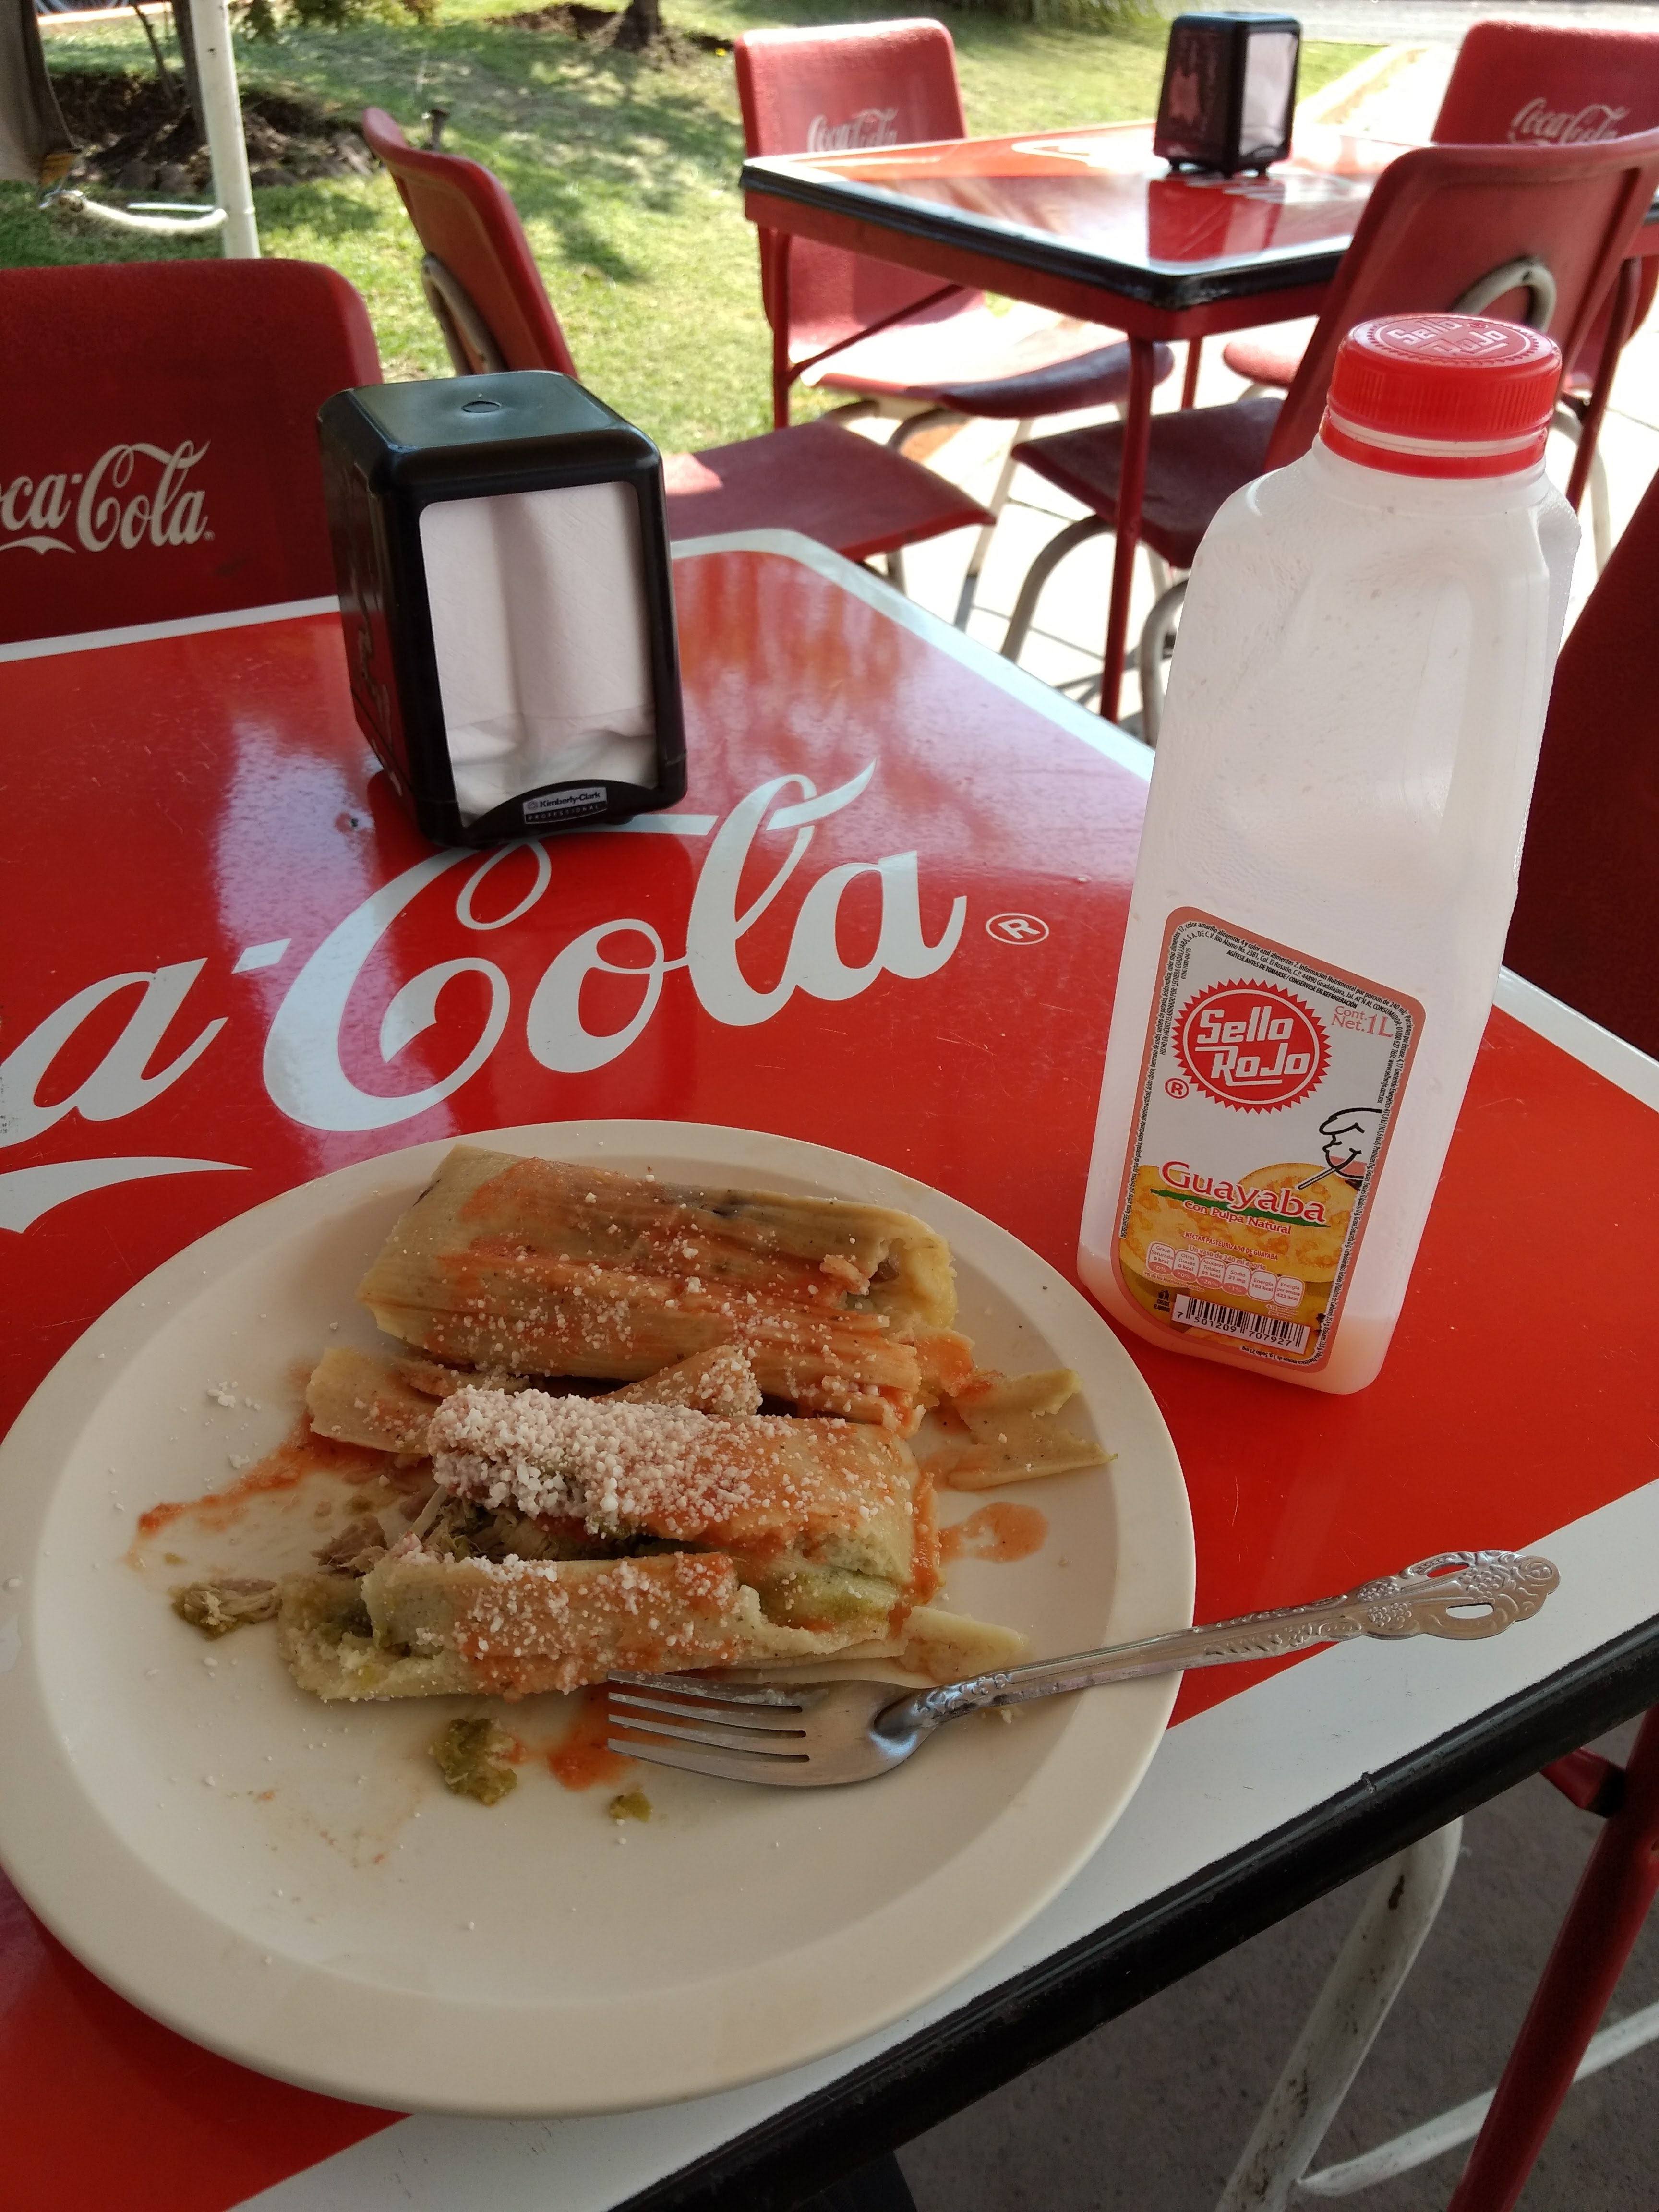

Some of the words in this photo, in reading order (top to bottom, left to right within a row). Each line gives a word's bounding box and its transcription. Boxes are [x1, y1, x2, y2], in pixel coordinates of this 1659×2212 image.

[0, 439, 211, 552] ca-Cola
[540, 792, 601, 808] Kimberly-Clark
[529, 805, 600, 821] PROFESSIONAL
[1198, 923, 1217, 932] amarillo
[1168, 931, 1180, 952] alimentos
[1217, 930, 1240, 943] alimentos
[1222, 937, 1239, 949] Álamo
[1175, 939, 1190, 968] GUADALAJARA,
[1246, 949, 1259, 960] 2381,
[1248, 943, 1260, 951] color
[1169, 951, 1178, 961] rojo
[1181, 947, 1191, 979] 01NG1000-04/15
[1260, 955, 1268, 963] Col.
[1270, 953, 1295, 965] alimentos
[1166, 960, 1174, 971] color
[1274, 962, 1292, 974] Rosario,
[1299, 964, 1327, 980] Información
[1162, 971, 1173, 986] málico,
[1171, 969, 1180, 986] LECHERA
[1226, 950, 1245, 961] AGÍTESE
[1244, 958, 1260, 967] ANTES
[1265, 966, 1286, 979] TOMARSE
[1289, 977, 1317, 991] CONSÉRVESE
[1322, 990, 1358, 1009] REFRIGERACIÓN
[1301, 974, 1317, 983] 44890
[1327, 976, 1357, 991] Nutrimental
[1317, 980, 1345, 997] Guadalajara,
[1355, 989, 1365, 997] por
[1354, 996, 1366, 1004] AT'N
[1364, 991, 1383, 1003] porción
[1157, 997, 1168, 1013] potasio,
[1165, 997, 1175, 1021] ELABORADO
[1334, 1005, 1367, 1021] Cont.
[1373, 1003, 1400, 1026] CONSUMIDOR:
[1161, 1020, 1171, 1036] MÉXICO
[1196, 1006, 1294, 1044] Sello
[1331, 1014, 1365, 1032] Net.
[1367, 1013, 1394, 1038] 1L
[1395, 1025, 1403, 1040] 01800
[1405, 1015, 1413, 1036] Porciones
[1153, 1033, 1162, 1045] sodio,
[1149, 1049, 1158, 1067] benzoato
[1389, 1049, 1398, 1059] 7656
[1398, 1044, 1408, 1059] Envase:
[1396, 1059, 1404, 1068] 4,17
[1147, 1067, 1156, 1080] cítrico,
[1390, 1068, 1402, 1089] Contenido
[1377, 1059, 1394, 1104] www.sellorojo.com.mx
[1143, 1090, 1152, 1106] artificial,
[1384, 1088, 1396, 1109] Energético
[1140, 1106, 1148, 1121] sintético
[1381, 1108, 1391, 1119] 431,8
[1136, 1121, 1146, 1142] saborizante
[1377, 1124, 1386, 1136] (101,6
[1373, 1136, 1383, 1146] kcal)
[1370, 1146, 1380, 1164] Proteínas
[1131, 1162, 1141, 1173] pulpa
[1128, 1172, 1138, 1187] fructosa,
[1365, 1170, 1373, 1182] Grasas
[1162, 1161, 1325, 1224] Guayaba
[1361, 1181, 1370, 1195] Totales
[1125, 1192, 1134, 1204] azúcar
[1356, 1194, 1367, 1210] (Lípidos)
[1124, 1203, 1133, 1214] Agua,
[1183, 1199, 1209, 1214] Con
[1210, 1206, 1246, 1223] Pulpa
[1248, 1215, 1291, 1234] Natural
[1352, 1217, 1360, 1226] Grasa
[1120, 1214, 1130, 1238] INGREDIENTES:
[1348, 1226, 1358, 1242] Saturada
[1184, 1232, 1205, 1242] NÉCTAR
[1206, 1236, 1245, 1252] PASTEURIZADO
[1254, 1250, 1278, 1260] GUAYABA
[1150, 1250, 1174, 1260] Saturada
[1340, 1249, 1352, 1272] Carbohidratos
[1202, 1258, 1224, 1268] Azúcares
[1245, 1260, 1267, 1272] aporta
[1336, 1271, 1346, 1284] Totales
[1333, 1283, 1343, 1298] (Hidratos
[1327, 1302, 1337, 1316] Carbono)
[1194, 1316, 1237, 1332] 501209
[1249, 1329, 1292, 1346] 707927
[1321, 1327, 1330, 1341] Azúcares
